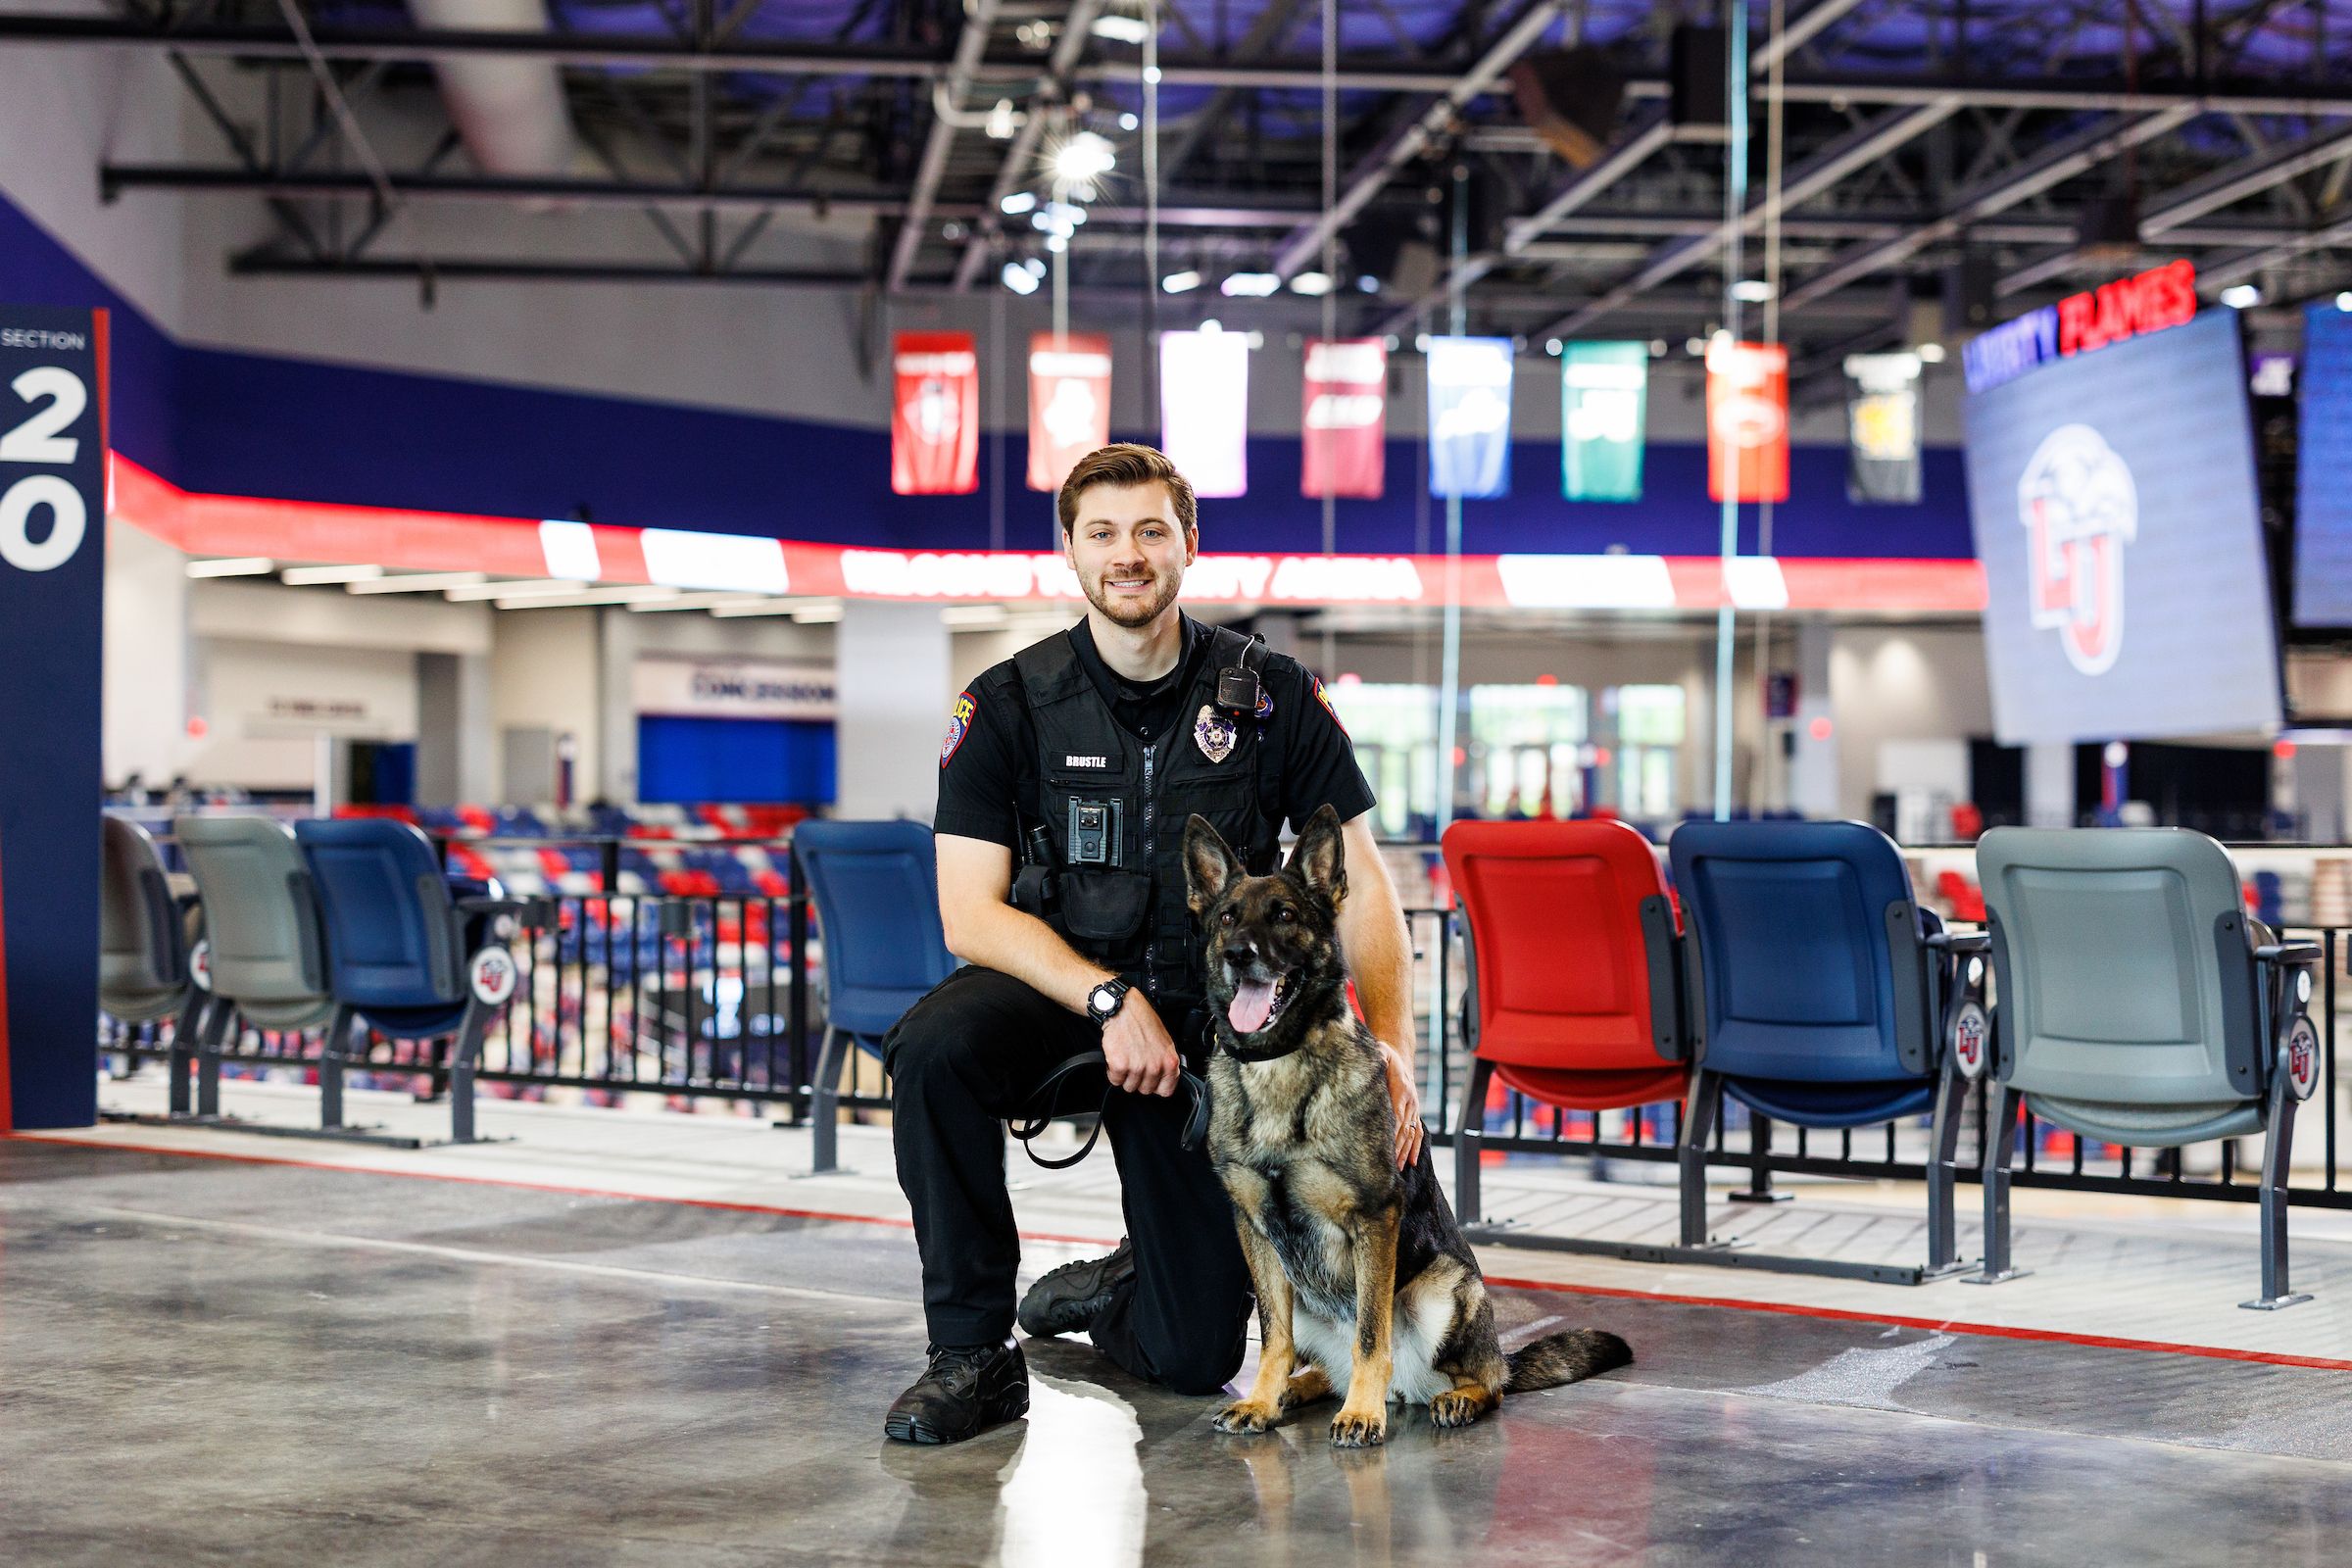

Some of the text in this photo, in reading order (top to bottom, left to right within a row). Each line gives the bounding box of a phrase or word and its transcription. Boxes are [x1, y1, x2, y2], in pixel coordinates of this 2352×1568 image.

[2059, 259, 2196, 358] FLAMES
[0, 328, 86, 350] SECTION
[1065, 756, 1107, 768] BRUSTLE
